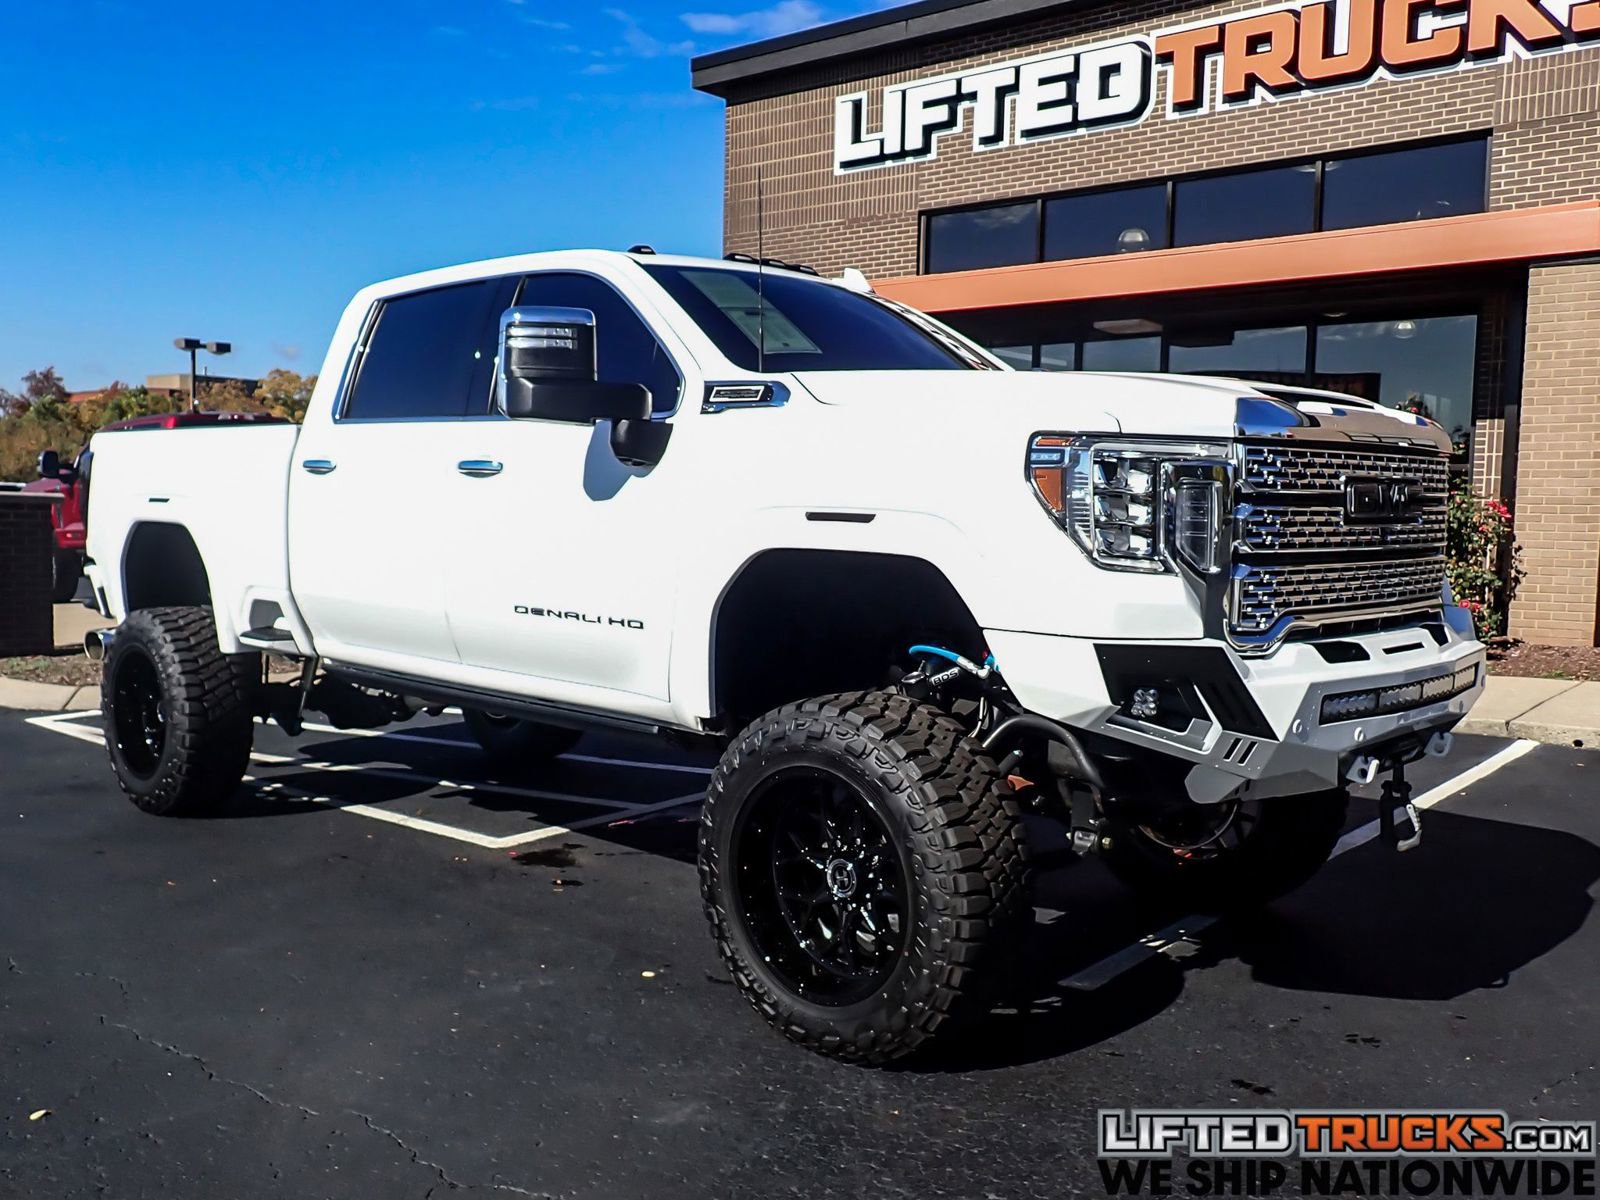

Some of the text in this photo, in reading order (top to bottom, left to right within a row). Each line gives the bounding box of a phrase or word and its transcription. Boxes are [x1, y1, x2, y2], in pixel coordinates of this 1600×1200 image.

[837, 36, 1153, 172] LIFTED
[513, 605, 645, 630] DENALI HD
